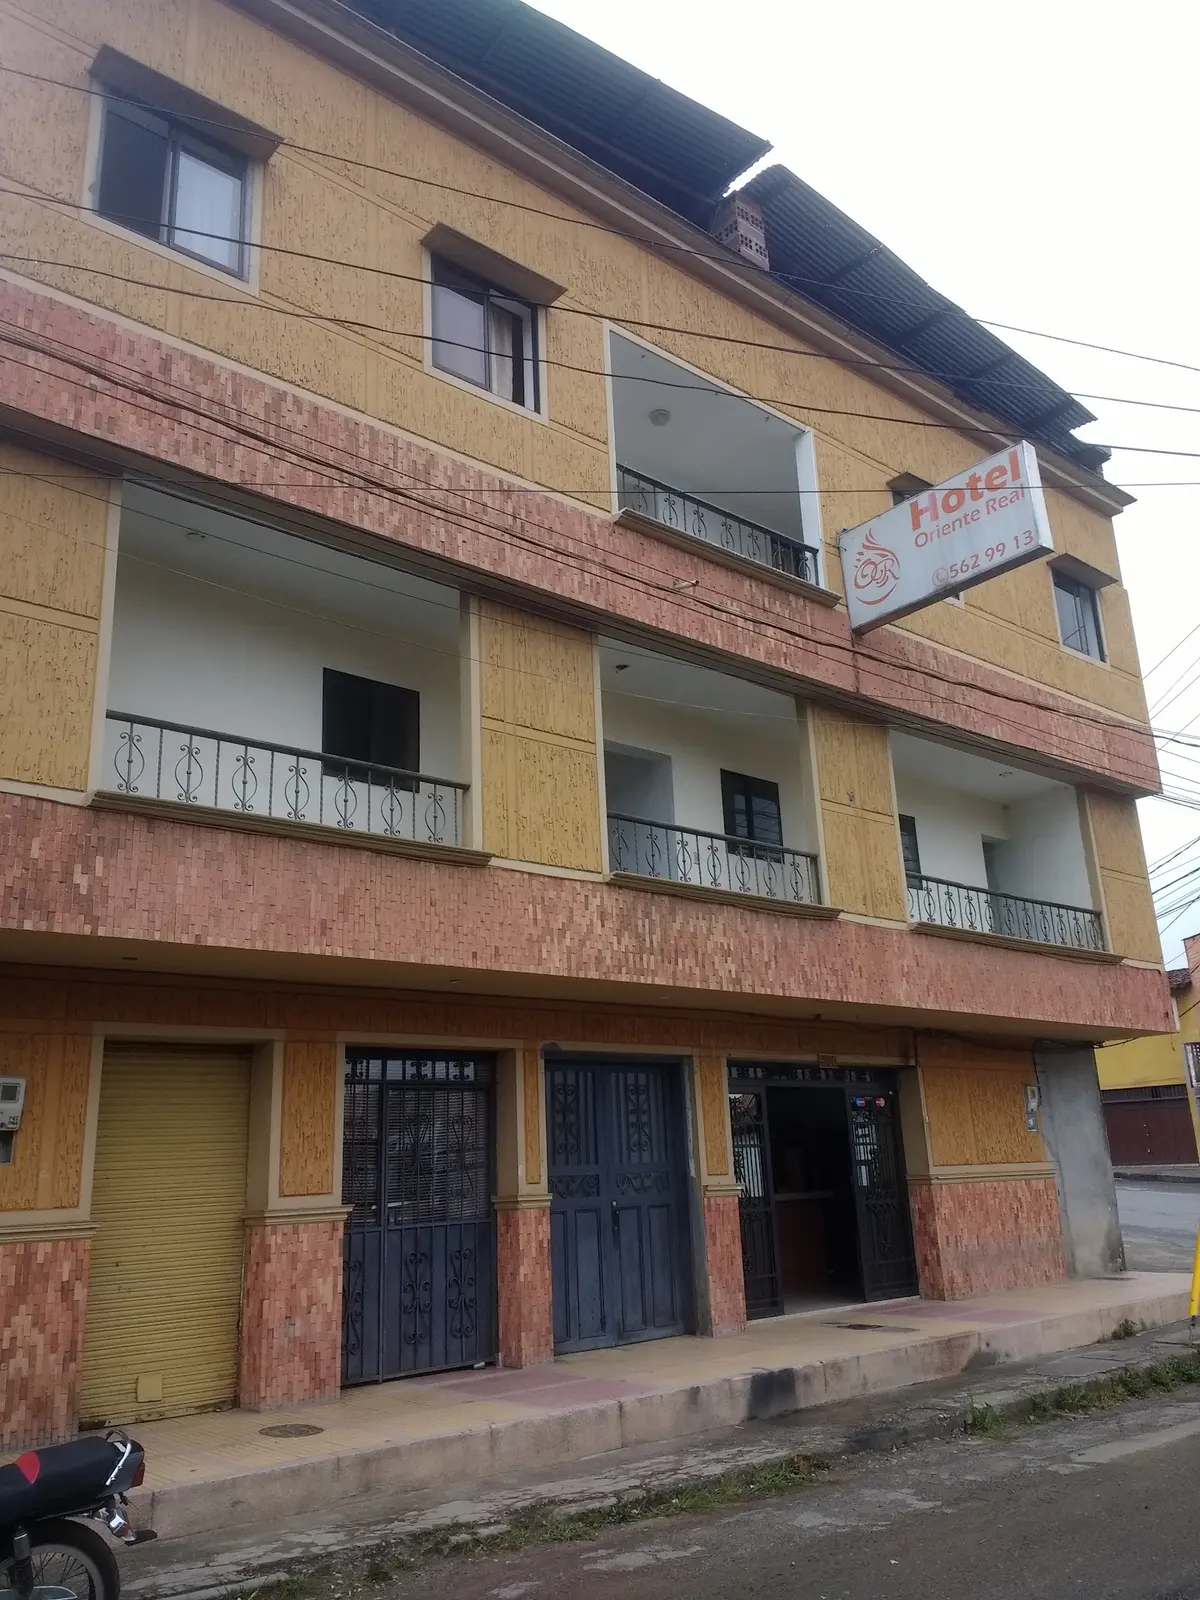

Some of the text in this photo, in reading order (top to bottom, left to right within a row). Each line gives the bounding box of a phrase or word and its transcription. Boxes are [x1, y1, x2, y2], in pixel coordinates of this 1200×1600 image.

[909, 449, 1020, 531] Hotel
[914, 483, 1025, 547] Oriente Real
[949, 529, 1034, 579] 562 99 13
